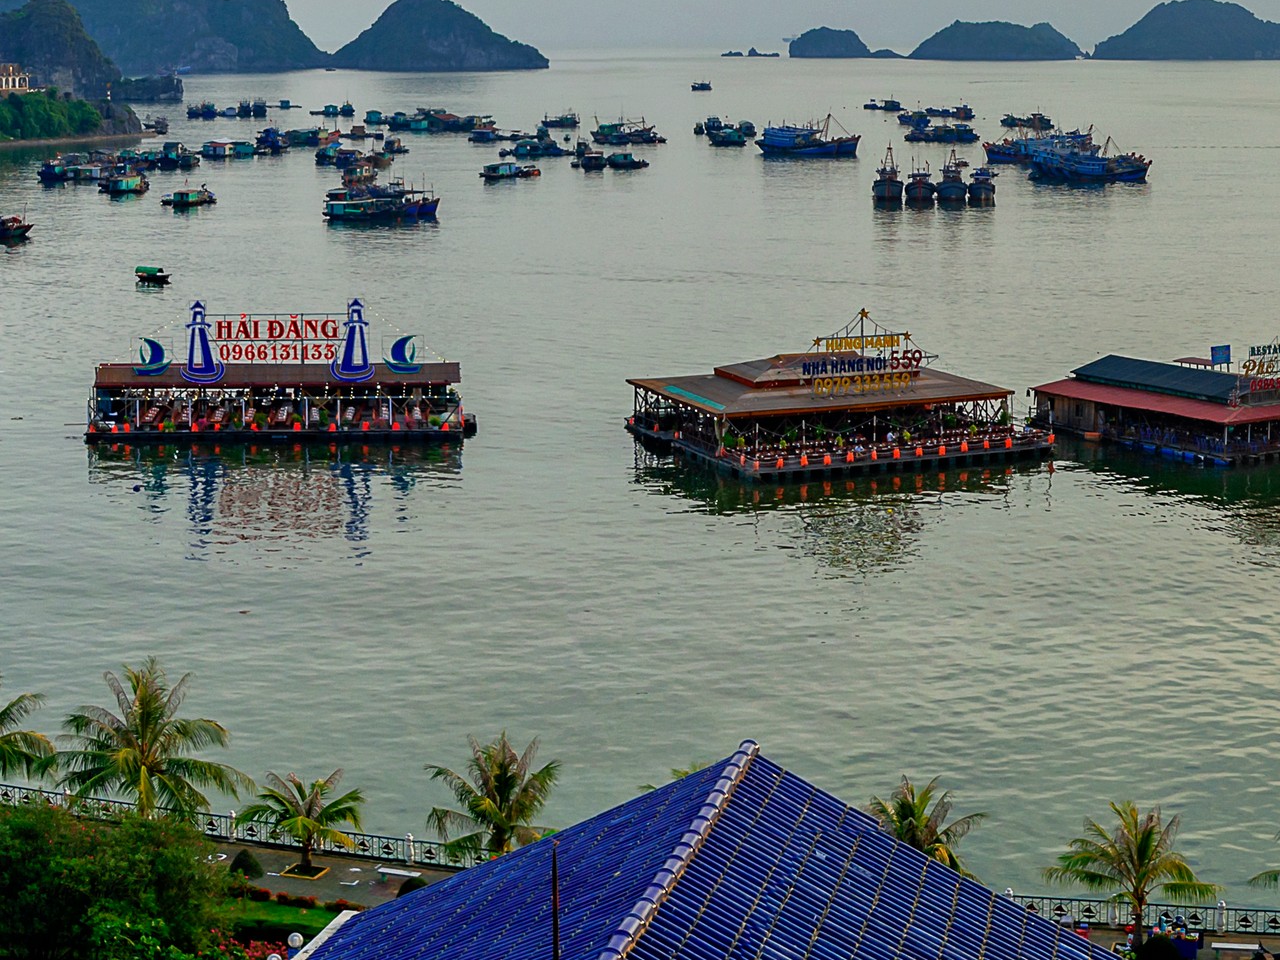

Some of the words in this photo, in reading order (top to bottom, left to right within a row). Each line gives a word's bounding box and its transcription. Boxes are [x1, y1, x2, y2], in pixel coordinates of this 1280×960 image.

[215, 313, 260, 339] HẢI
[267, 314, 339, 339] ĐĂNG
[220, 344, 335, 360] 0966131133
[890, 349, 922, 370] 559
